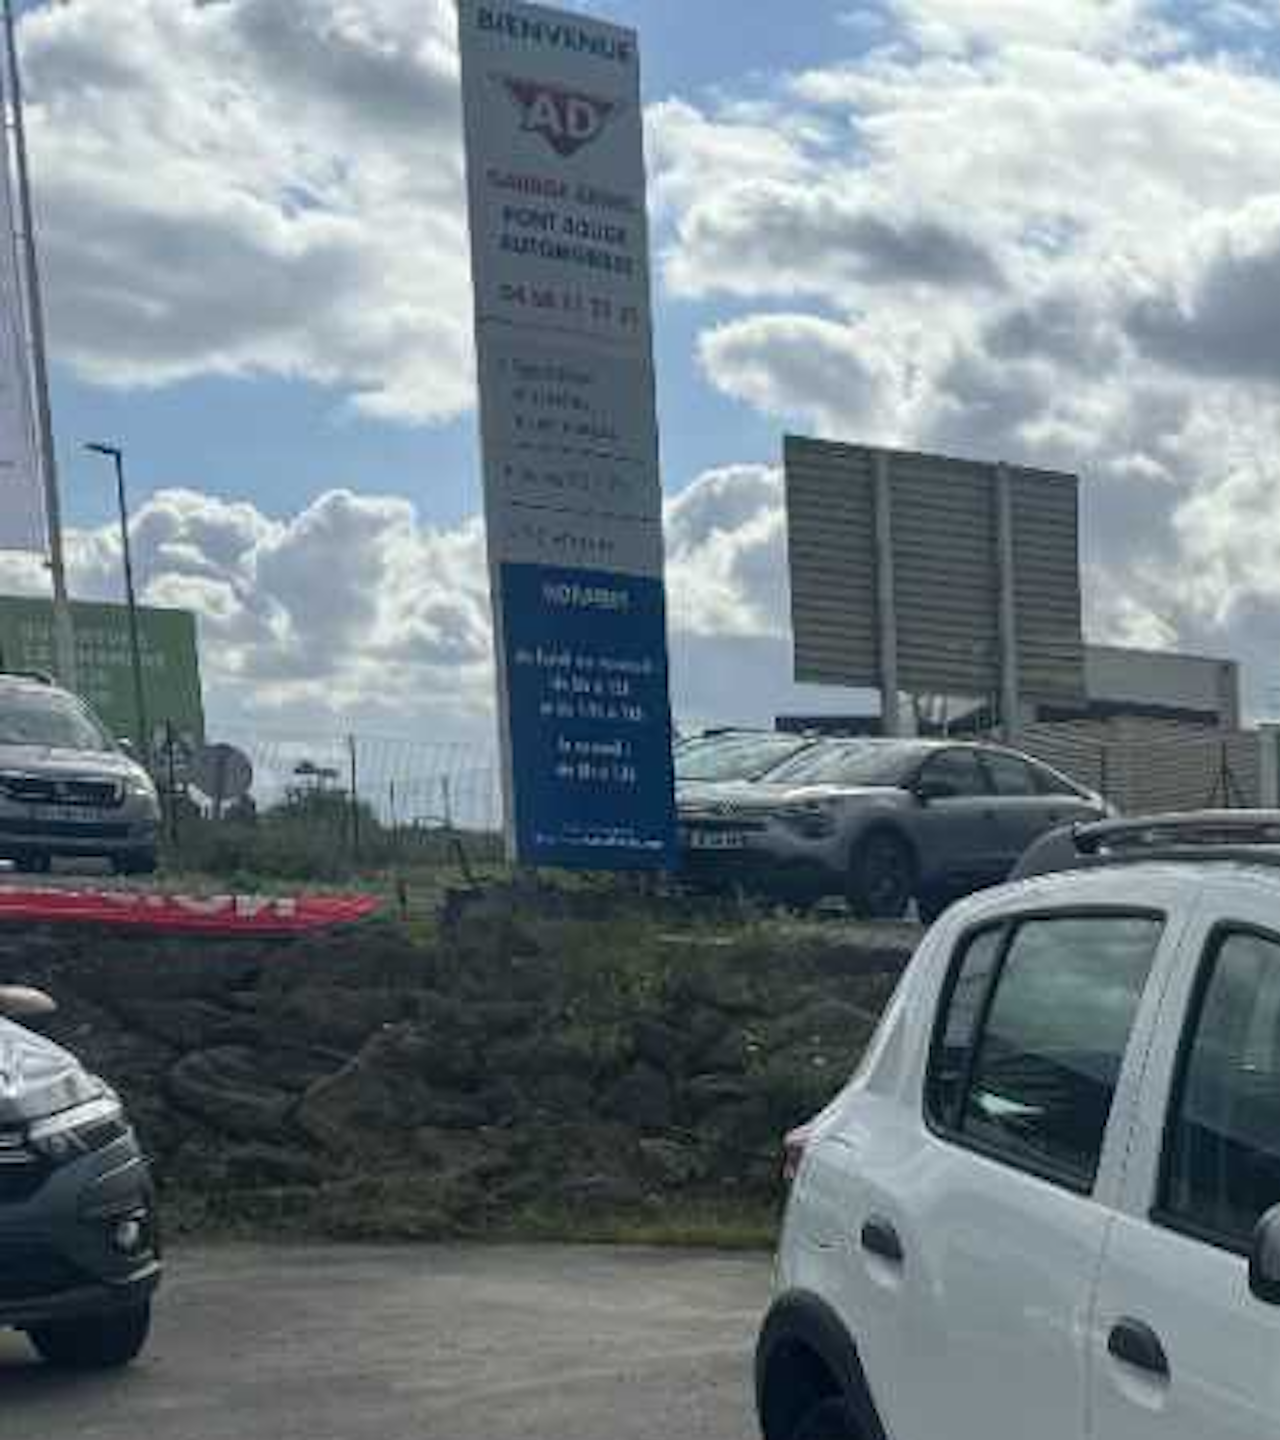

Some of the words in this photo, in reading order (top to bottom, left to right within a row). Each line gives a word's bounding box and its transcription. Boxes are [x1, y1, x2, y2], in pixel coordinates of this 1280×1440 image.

[477, 7, 632, 64] BIENVENUE
[526, 94, 599, 140] AD
[503, 205, 556, 231] PONT
